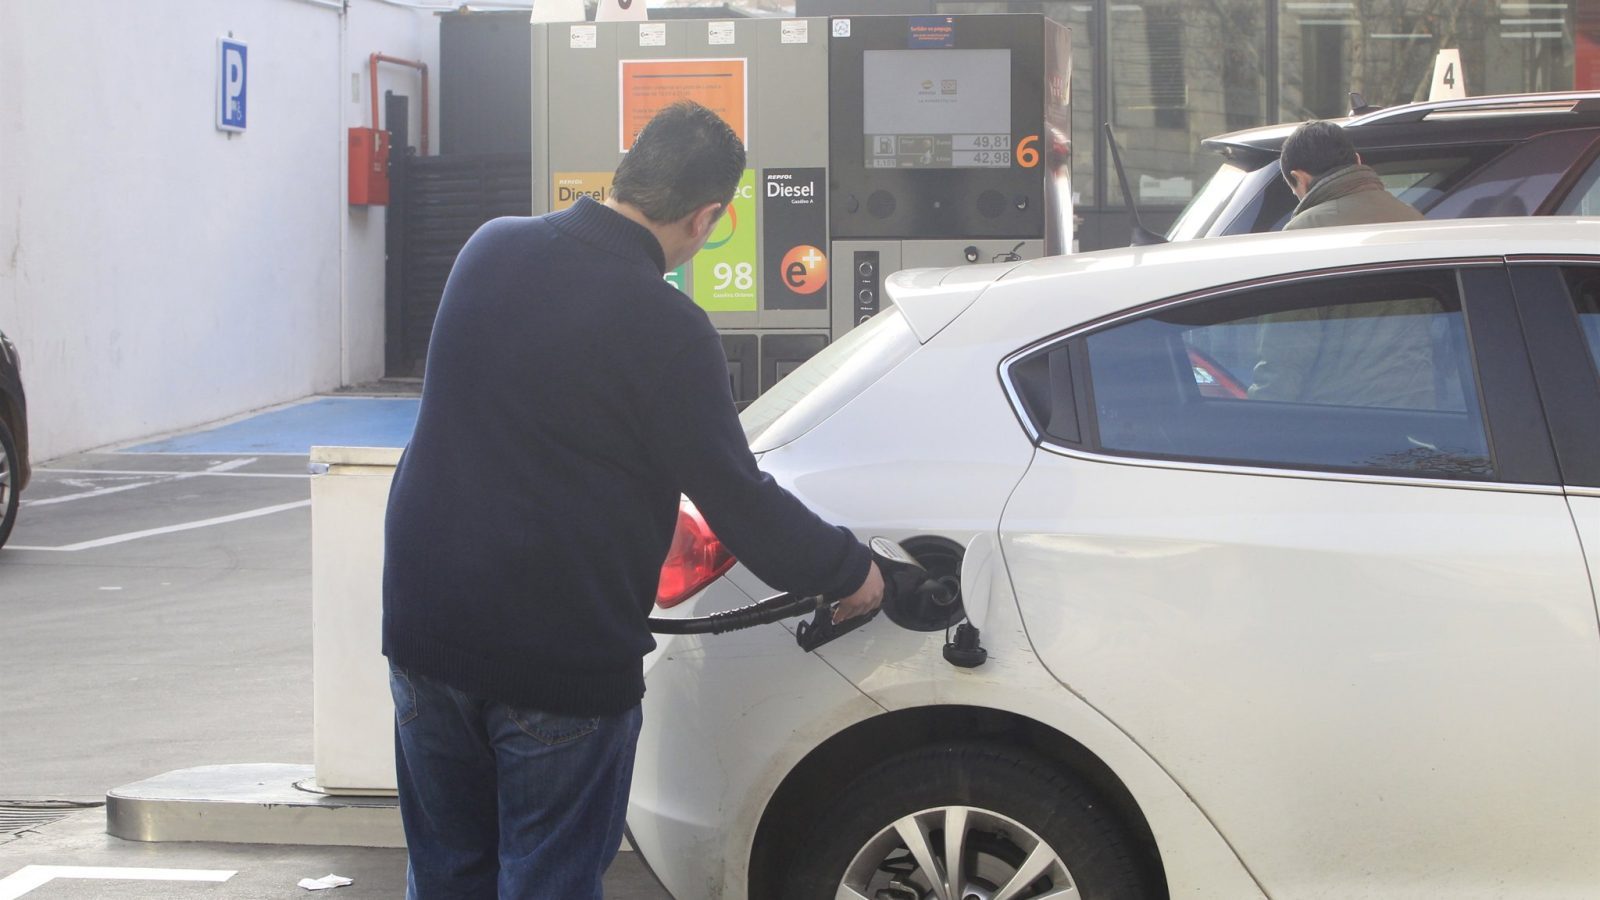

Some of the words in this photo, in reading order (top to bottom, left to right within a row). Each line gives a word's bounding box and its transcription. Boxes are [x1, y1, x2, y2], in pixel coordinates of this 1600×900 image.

[226, 48, 244, 120] P
[1443, 62, 1455, 89] 4
[973, 136, 1010, 149] 49,81
[1016, 135, 1039, 168] 6
[973, 152, 1010, 165] 42,98
[559, 186, 605, 202] Diesel
[767, 181, 814, 197] Diesel
[713, 262, 753, 290] 98
